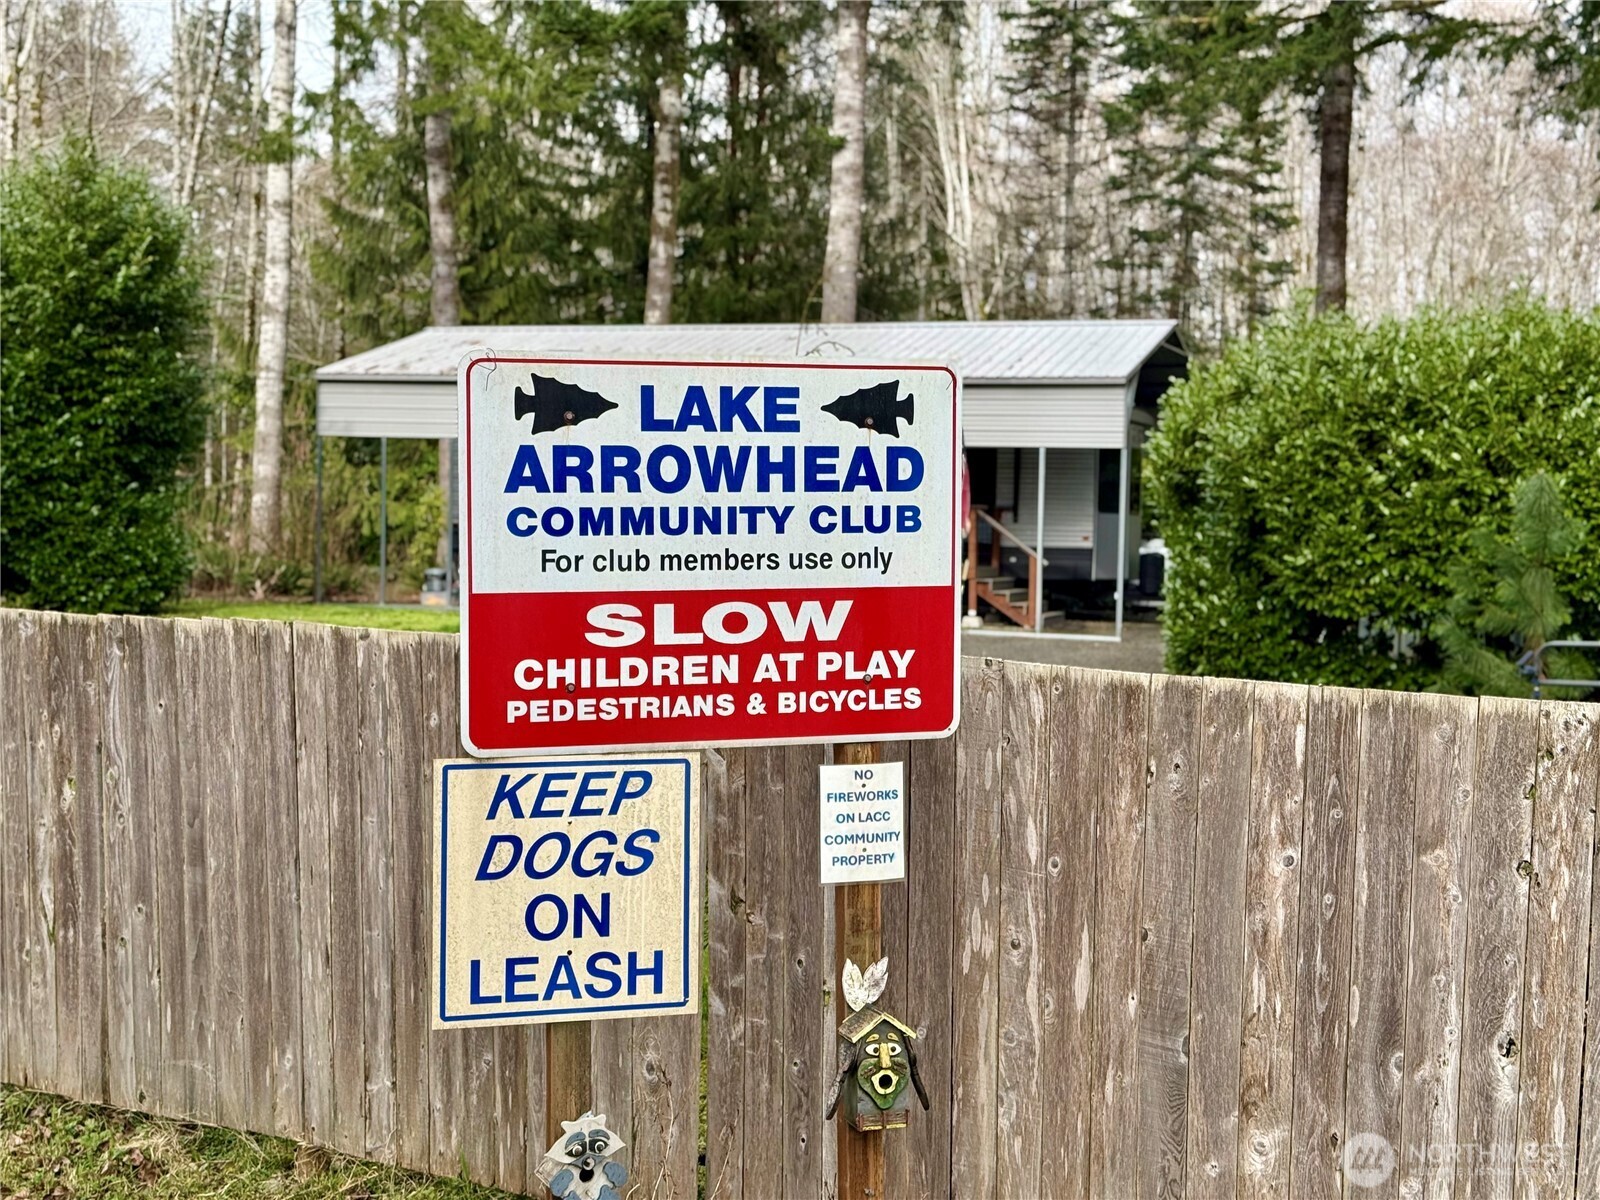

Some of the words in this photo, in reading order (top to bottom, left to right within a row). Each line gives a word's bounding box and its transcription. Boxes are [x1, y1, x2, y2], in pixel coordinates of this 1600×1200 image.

[641, 385, 801, 432] LAKE
[504, 445, 924, 493] ARROWHEAD
[507, 505, 795, 537] COMMUNITY
[810, 504, 922, 534] CLUB
[541, 549, 584, 573] For
[592, 548, 651, 573] club
[660, 547, 780, 572] members
[789, 552, 833, 570] use
[841, 546, 893, 575] only
[585, 600, 853, 647] SLOW
[513, 654, 739, 691] CHILDREN
[752, 652, 805, 683] AT
[817, 649, 916, 681] PLAY
[506, 694, 735, 724] PEDESTRIANS
[746, 692, 767, 716] &
[777, 687, 922, 713] BICYCLES
[854, 769, 874, 781] NO
[485, 770, 653, 821] KEEP
[826, 789, 899, 803] FIREWORKS
[835, 812, 855, 824] ON
[858, 811, 891, 823] LACC
[475, 829, 660, 881] DOGS
[824, 831, 901, 846] COMMUNITY
[832, 852, 895, 867] PROPERTY
[525, 893, 610, 942] ON
[470, 950, 663, 1005] LEASH
